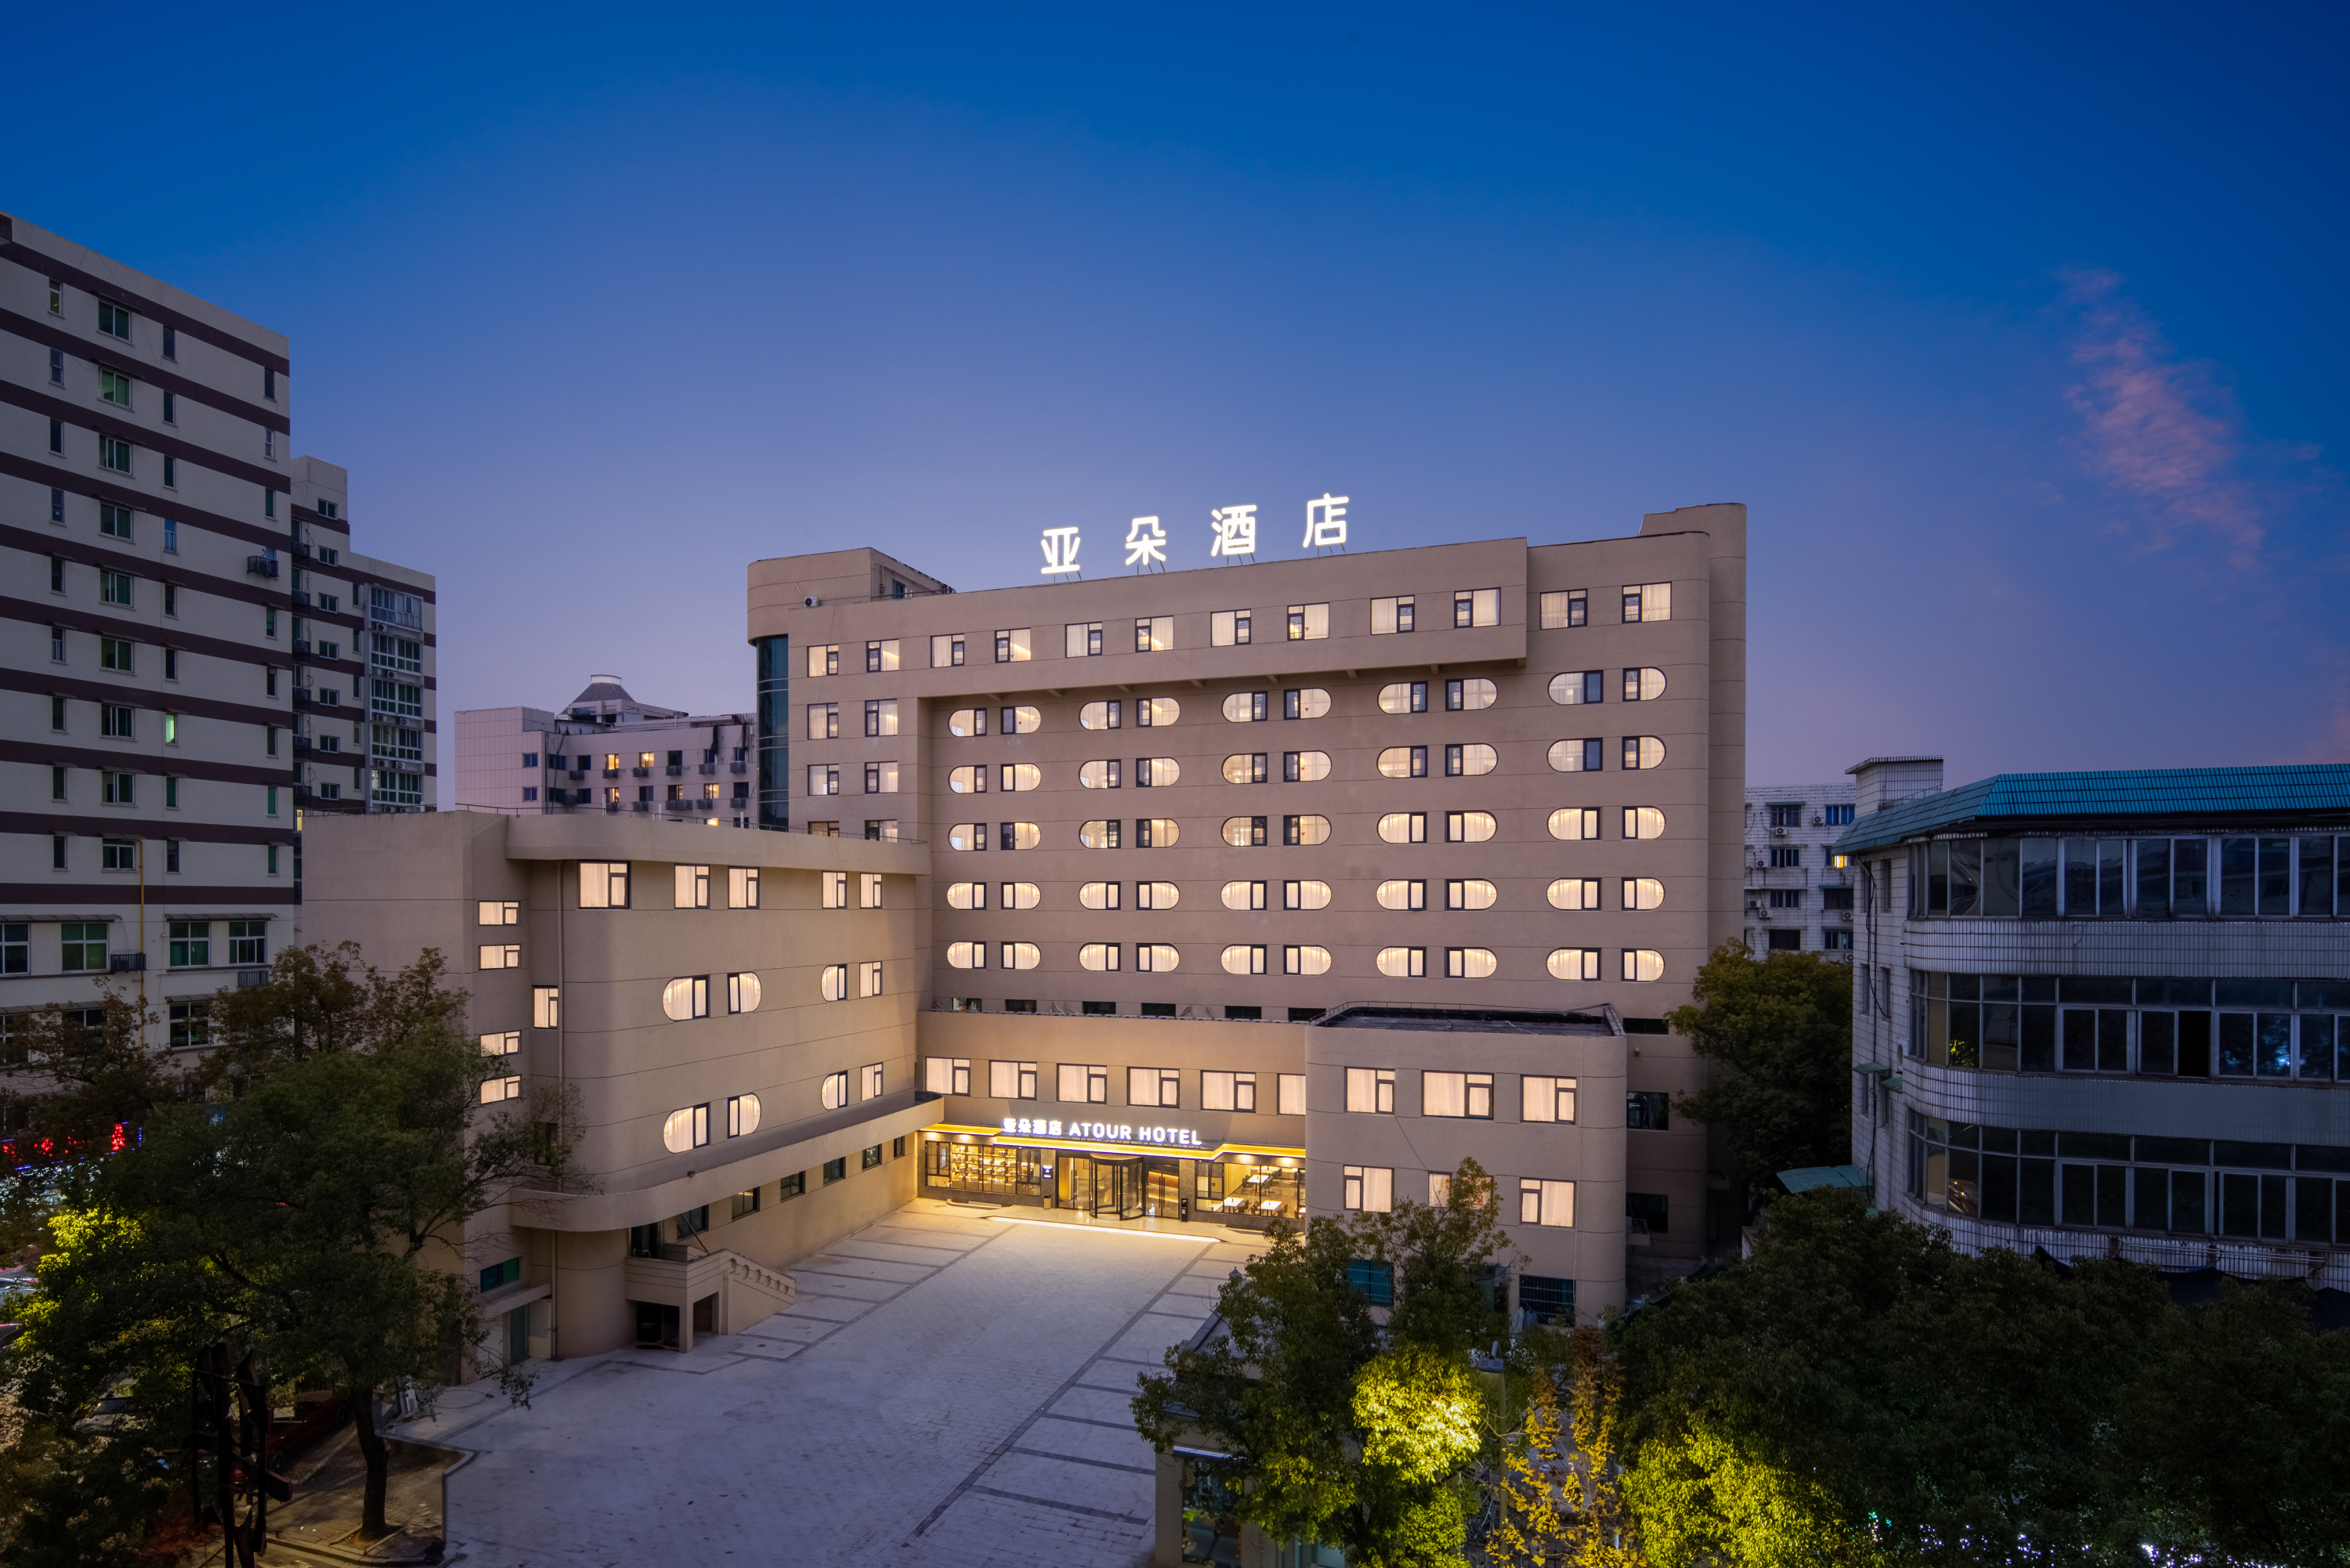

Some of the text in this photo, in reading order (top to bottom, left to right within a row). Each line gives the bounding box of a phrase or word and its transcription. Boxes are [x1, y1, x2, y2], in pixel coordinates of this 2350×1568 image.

[1040, 493, 1350, 574] 亚朵酒店
[1003, 1118, 1202, 1146] 亚朵酒店 ATOUR HOTEL
